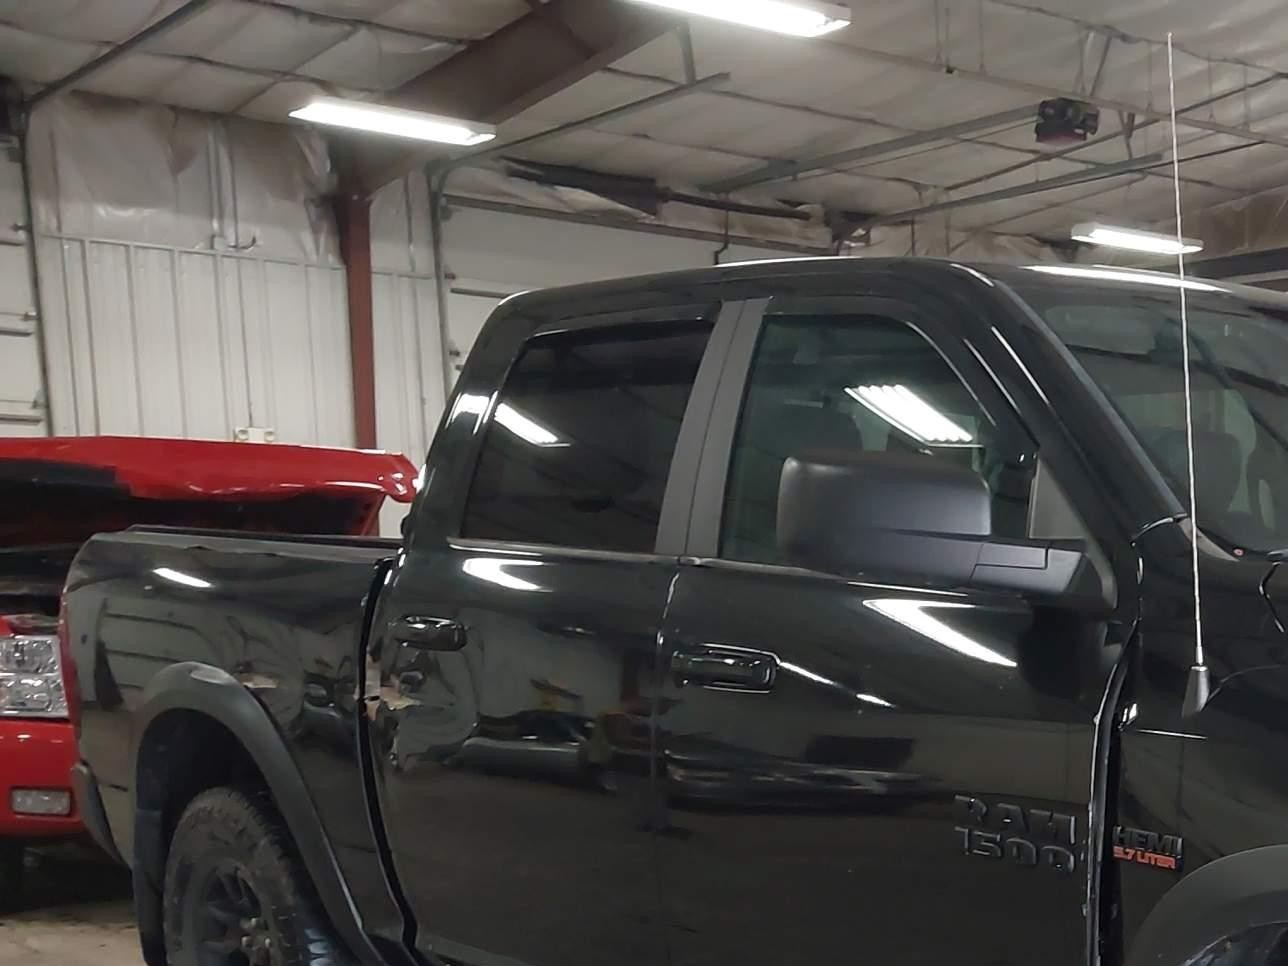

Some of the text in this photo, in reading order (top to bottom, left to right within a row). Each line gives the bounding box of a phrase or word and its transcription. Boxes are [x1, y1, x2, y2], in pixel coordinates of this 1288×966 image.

[953, 794, 1076, 846] RAM
[1112, 825, 1183, 859] HEMI
[953, 825, 1076, 873] 1500
